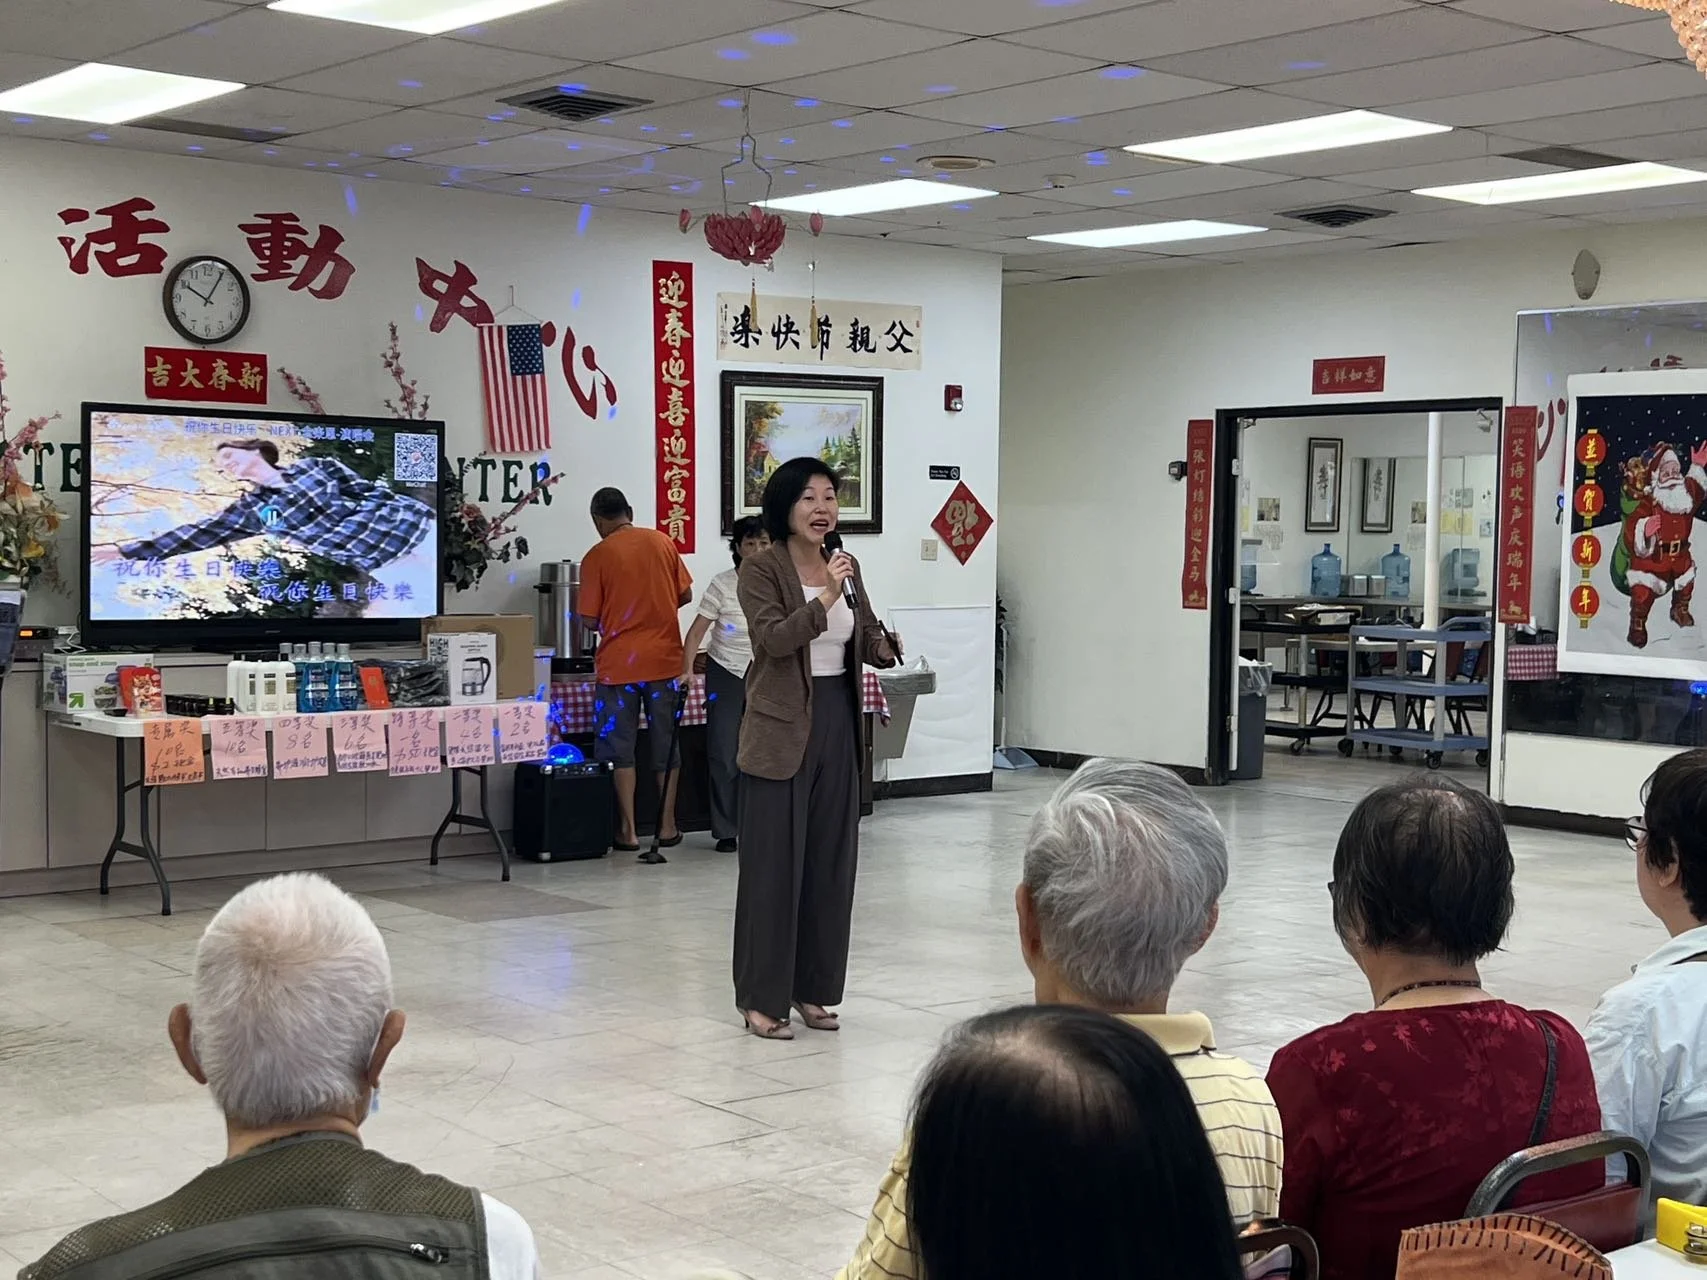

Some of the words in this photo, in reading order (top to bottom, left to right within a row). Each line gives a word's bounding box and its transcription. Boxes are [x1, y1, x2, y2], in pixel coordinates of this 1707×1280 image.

[658, 271, 693, 545] 迎春迎喜迎富貴
[1322, 365, 1377, 385] 吉祥如意
